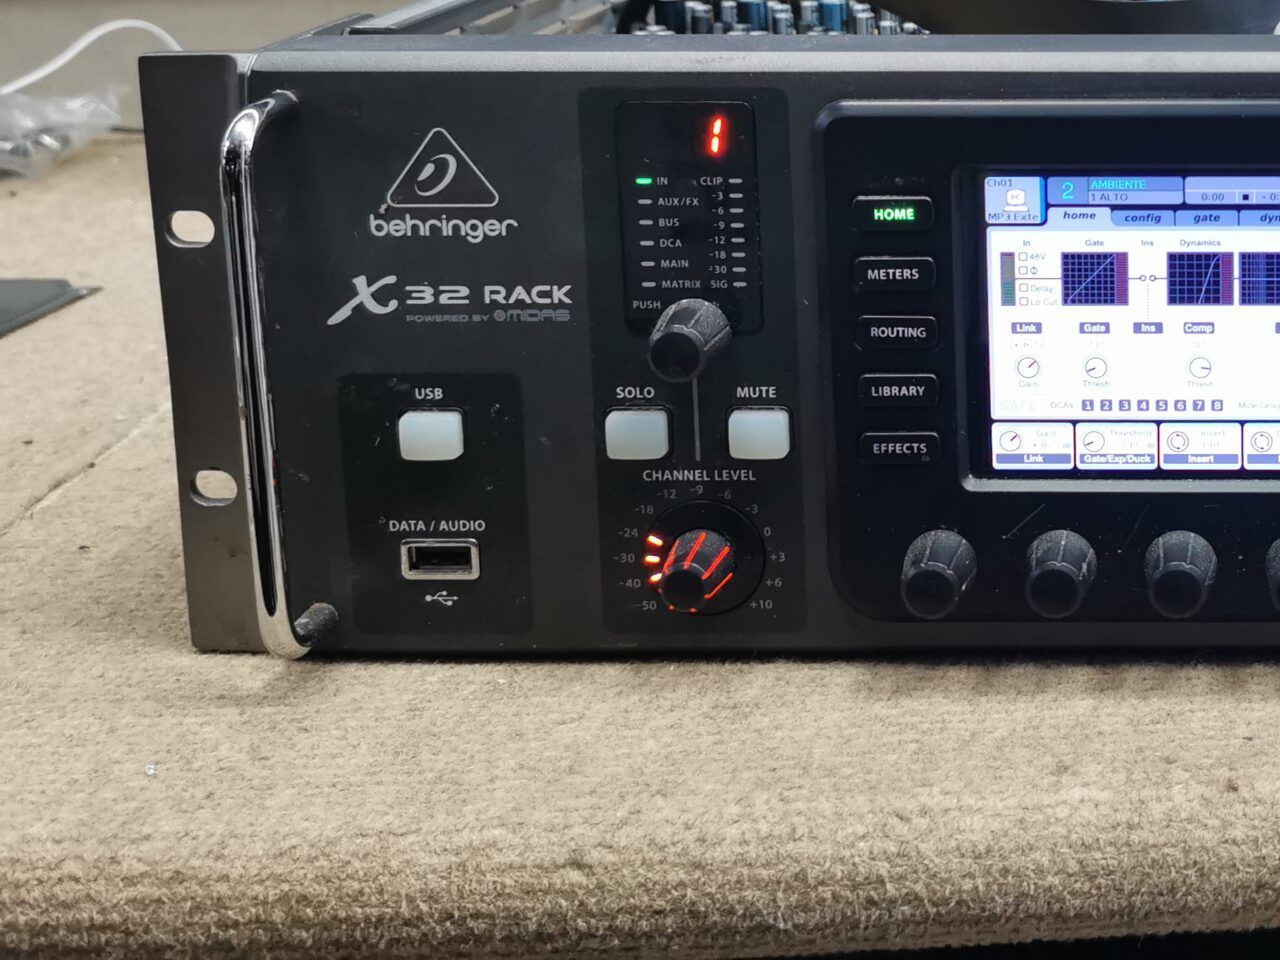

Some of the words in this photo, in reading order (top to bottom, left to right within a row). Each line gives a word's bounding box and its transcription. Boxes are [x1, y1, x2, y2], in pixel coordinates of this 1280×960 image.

[656, 176, 669, 186] IN
[699, 176, 724, 186] CLIP
[986, 178, 1013, 188] Ch01
[1090, 179, 1147, 190] AMBIENTE
[1061, 181, 1075, 200] 2
[657, 197, 700, 207] AUX/FX
[1099, 192, 1129, 202] ALTO
[1201, 192, 1225, 202] 0:00
[873, 208, 916, 222] HOME
[987, 212, 1012, 222] MP3
[1063, 210, 1097, 220] home
[1124, 213, 1163, 225] config
[1193, 214, 1221, 225] gate
[658, 217, 680, 228] BUS
[369, 213, 519, 244] behringer
[659, 238, 683, 248] DCA
[1084, 239, 1105, 248] Gate
[1179, 239, 1221, 249] Dynamics
[660, 259, 689, 269] MAIN
[867, 268, 920, 281] METERS
[661, 279, 702, 289] MATRIX
[710, 279, 728, 289] SIG
[483, 284, 573, 305] RACK
[632, 300, 661, 309] PUSH
[405, 314, 470, 323] POWERED
[472, 314, 490, 323] BY
[870, 326, 927, 339] ROUTING
[1016, 323, 1037, 332] Link
[1083, 323, 1106, 333] Gate
[1141, 323, 1156, 333] Ins
[1184, 323, 1213, 334] Comp
[414, 387, 444, 400] USB
[615, 386, 655, 399] SOLO
[736, 386, 777, 398] MUTE
[871, 385, 925, 397] LIBRARY
[872, 442, 928, 454] EFFECTS
[1024, 454, 1043, 463] Link
[1188, 454, 1214, 463] Insert
[642, 469, 710, 481] CHANNEL
[714, 469, 756, 481] LEVEL
[388, 519, 426, 532] DATA
[439, 519, 486, 532] AUDIO
[763, 527, 772, 537] 0
